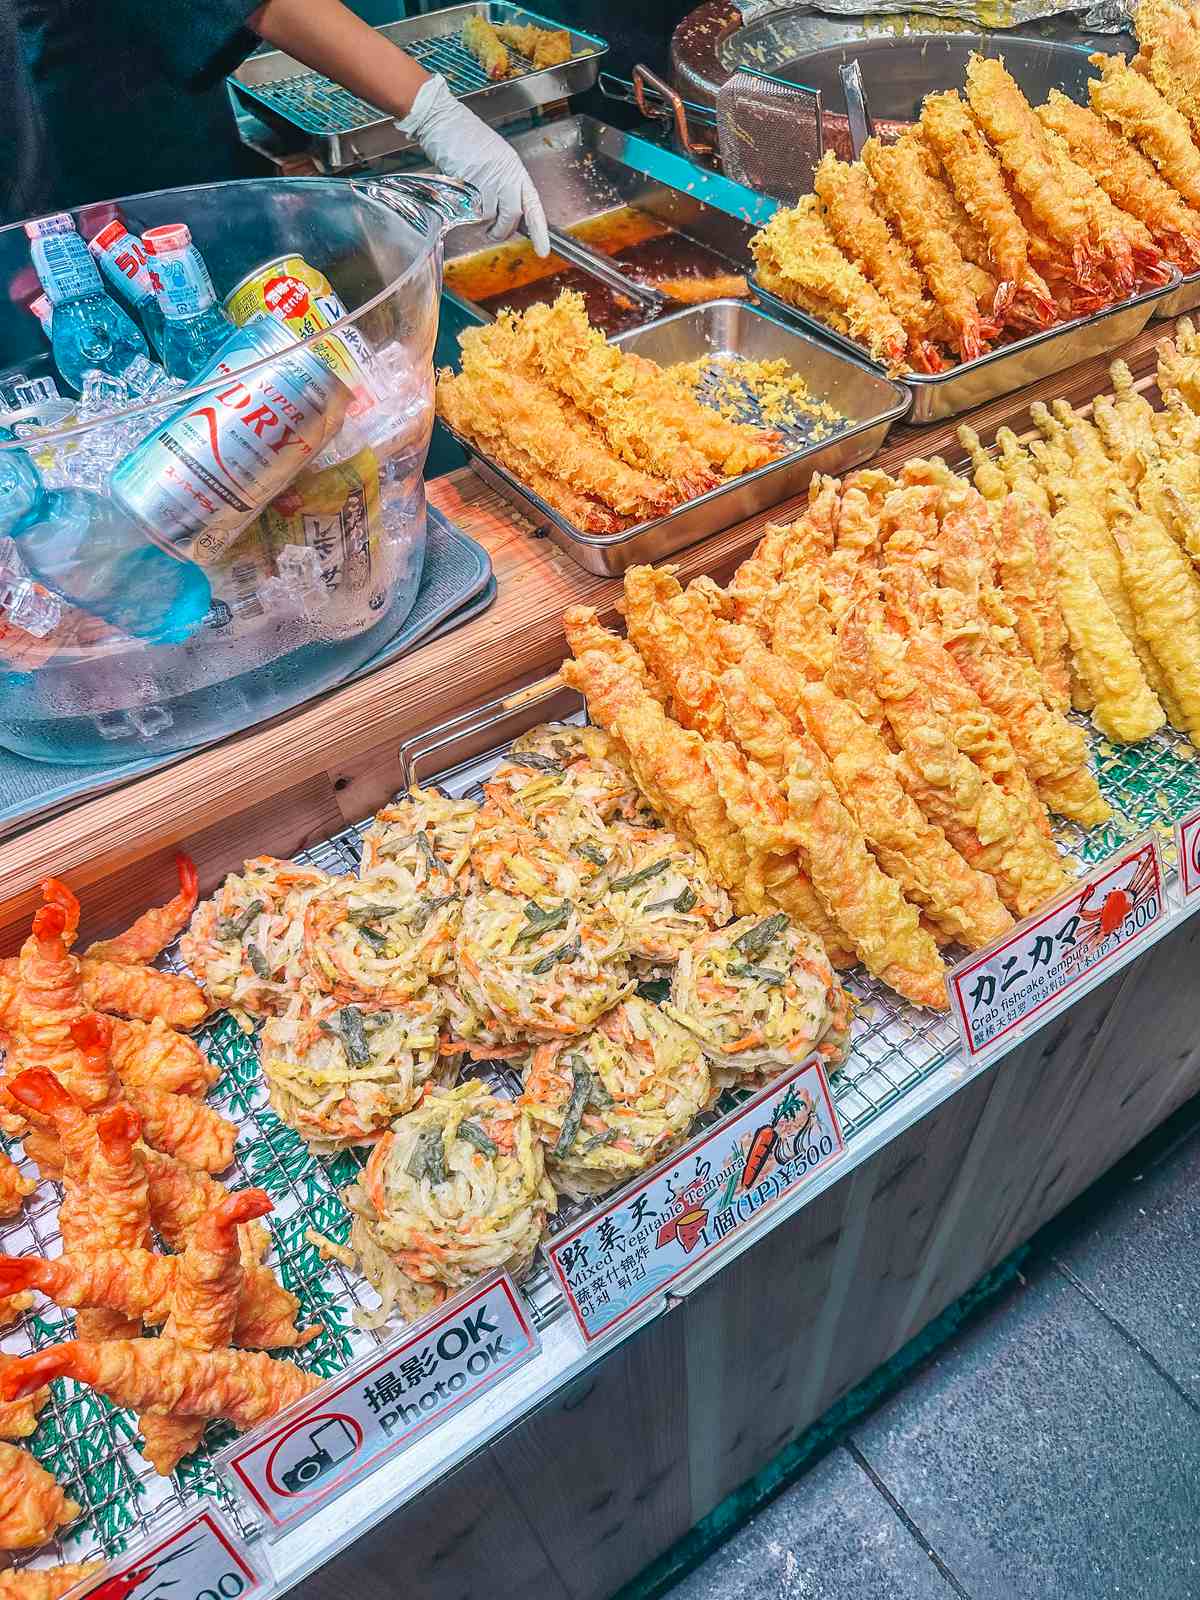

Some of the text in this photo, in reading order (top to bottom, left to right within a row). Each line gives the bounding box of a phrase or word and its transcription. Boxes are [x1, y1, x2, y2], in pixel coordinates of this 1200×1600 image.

[256, 379, 304, 424] SUPER
[969, 915, 1080, 1014] カニカマ
[971, 944, 1089, 1031] Crab fishcake tempura
[558, 1156, 711, 1275] 野菜天ぷら
[567, 1157, 745, 1290] Mixed Vegitable Tempura
[580, 1263, 647, 1318] 야채 튀김
[364, 1304, 499, 1414] 撮影OK
[378, 1335, 510, 1438] Photo OK
